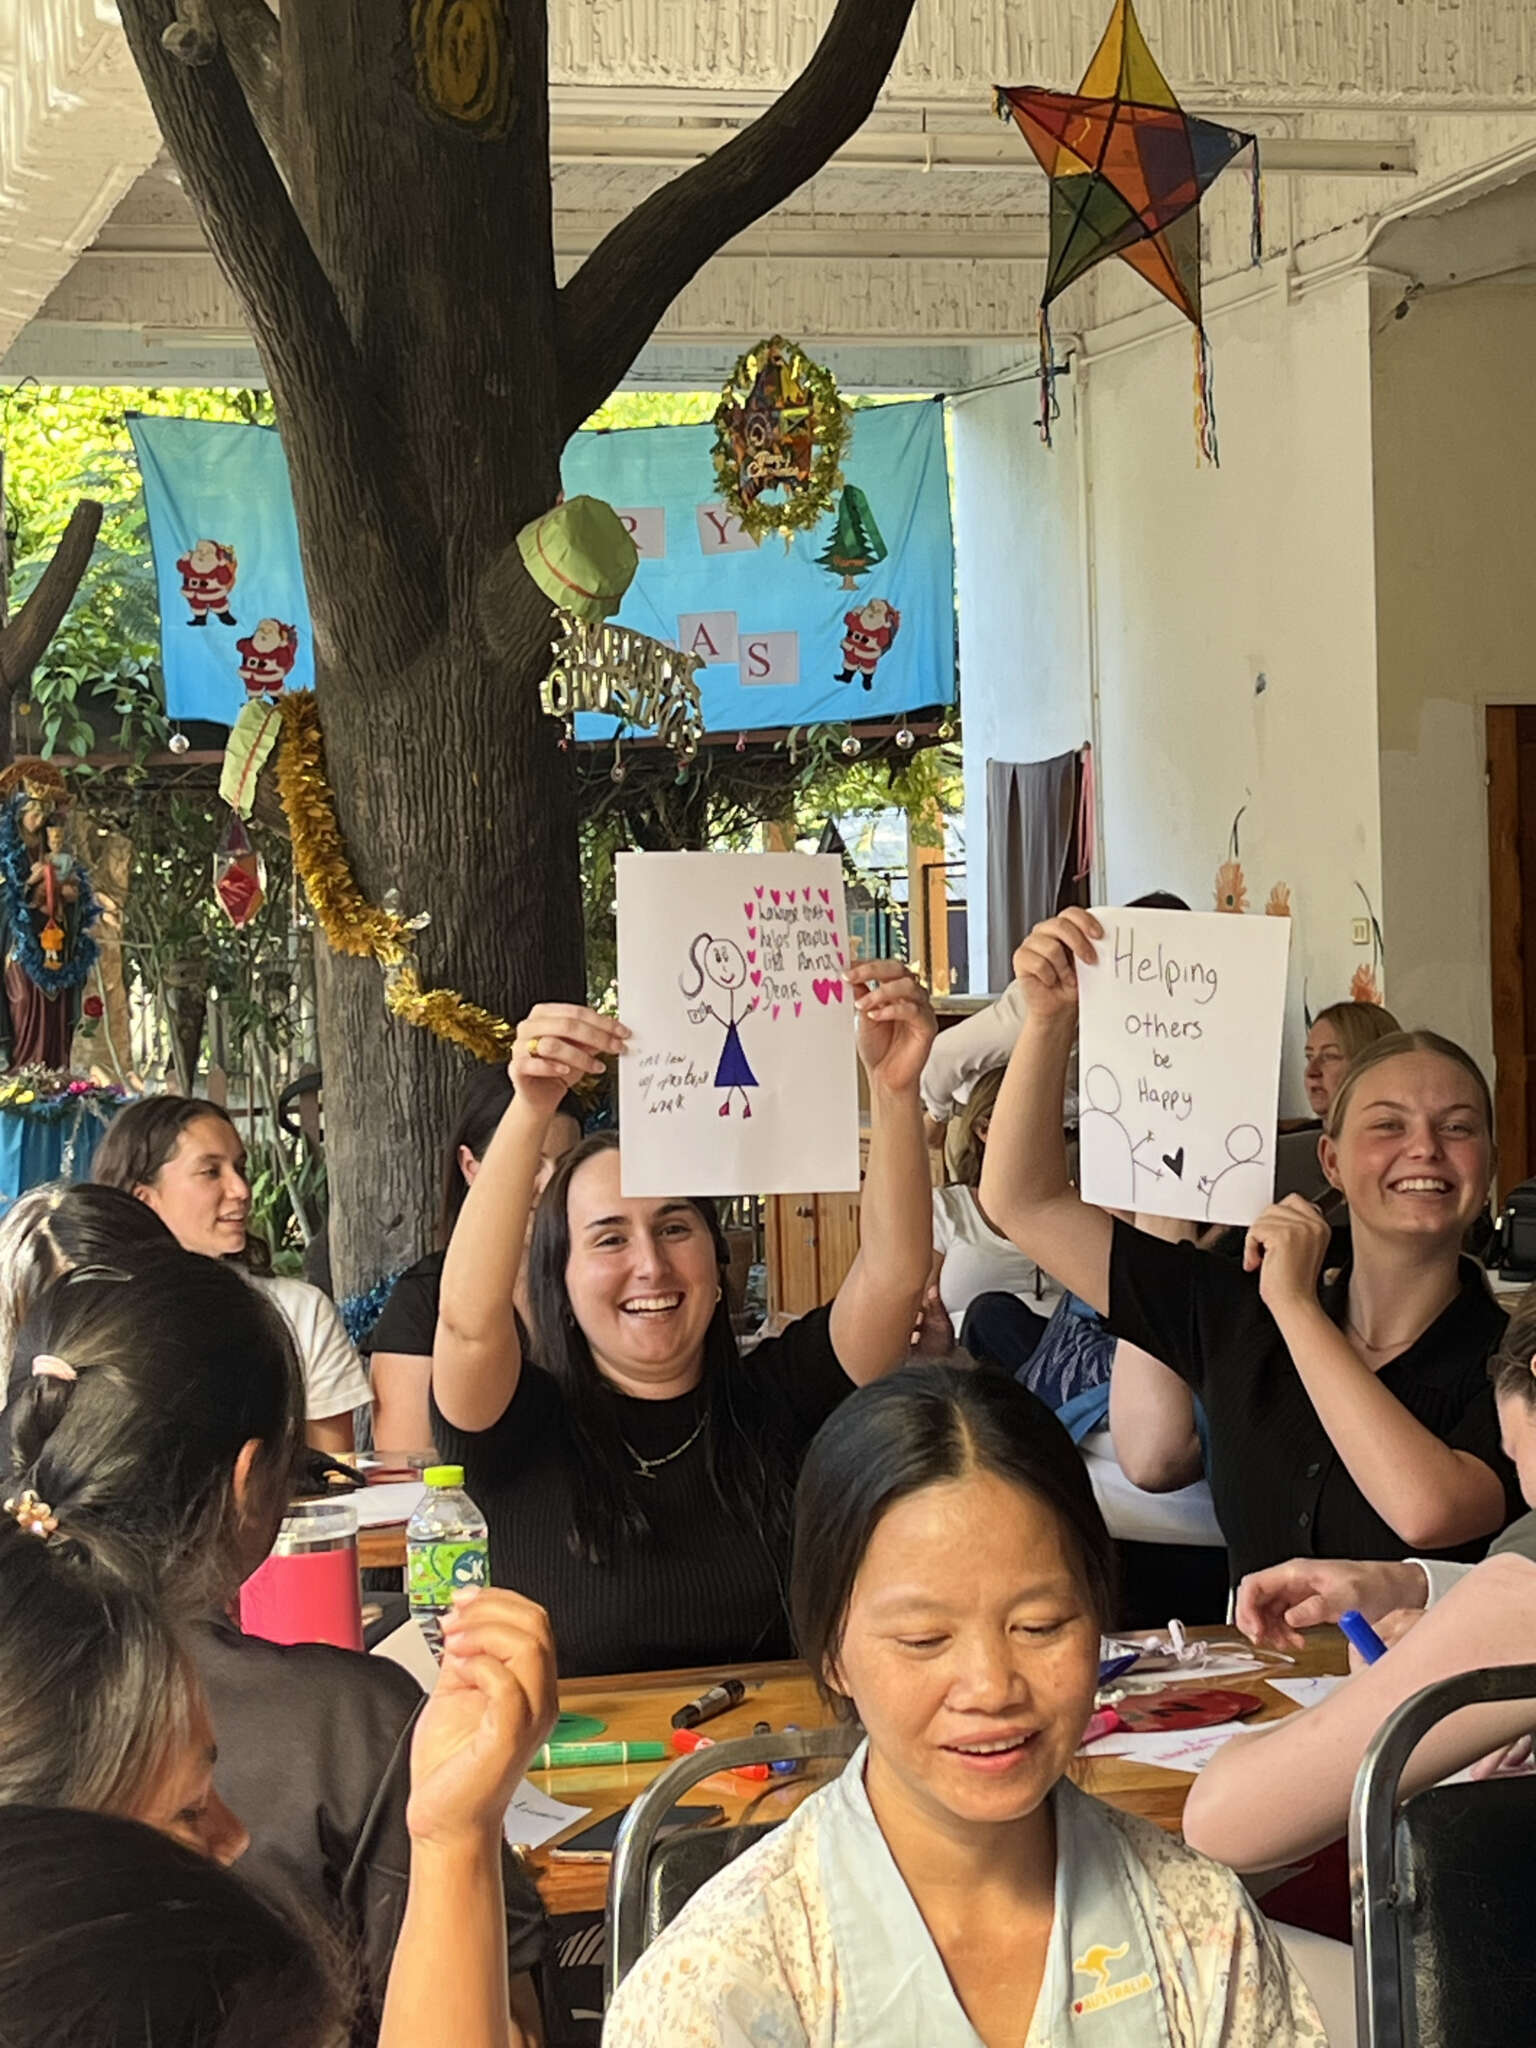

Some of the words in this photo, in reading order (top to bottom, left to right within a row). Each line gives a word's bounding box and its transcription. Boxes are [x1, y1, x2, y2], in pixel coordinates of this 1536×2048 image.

[704, 511, 734, 545] Y
[690, 621, 720, 656] A
[748, 642, 771, 678] S
[1114, 926, 1218, 1004] Helping
[1152, 1049, 1172, 1069] be
[1138, 1077, 1193, 1121] Happy
[1083, 1977, 1152, 2011] AUSTRALIA
